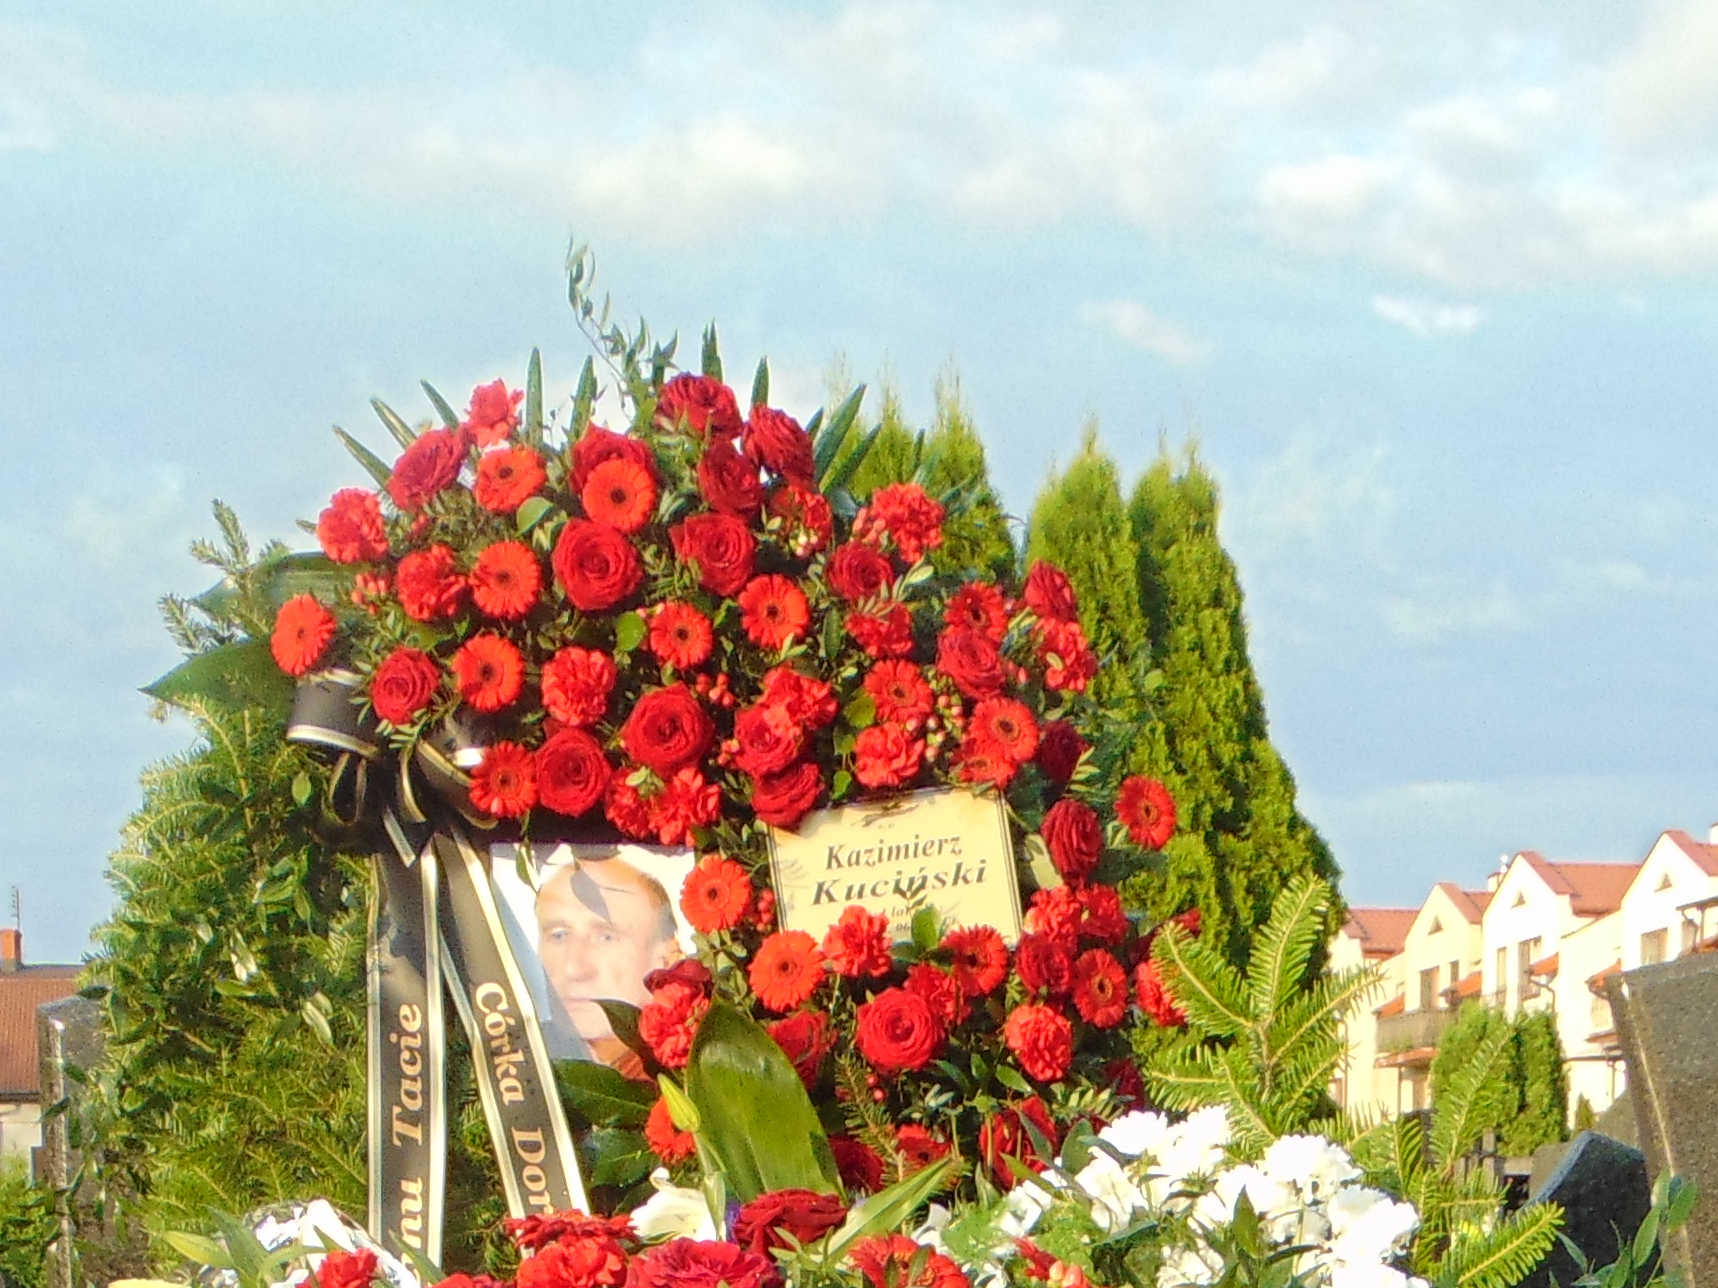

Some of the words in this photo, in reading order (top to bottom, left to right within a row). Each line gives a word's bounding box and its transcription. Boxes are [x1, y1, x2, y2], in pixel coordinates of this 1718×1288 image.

[811, 858, 989, 906] Kuciński
[824, 833, 964, 873] Kazimierz
[389, 1002, 424, 1148] Tacie
[474, 981, 526, 1107] Córka
[510, 1125, 555, 1216] Dor
